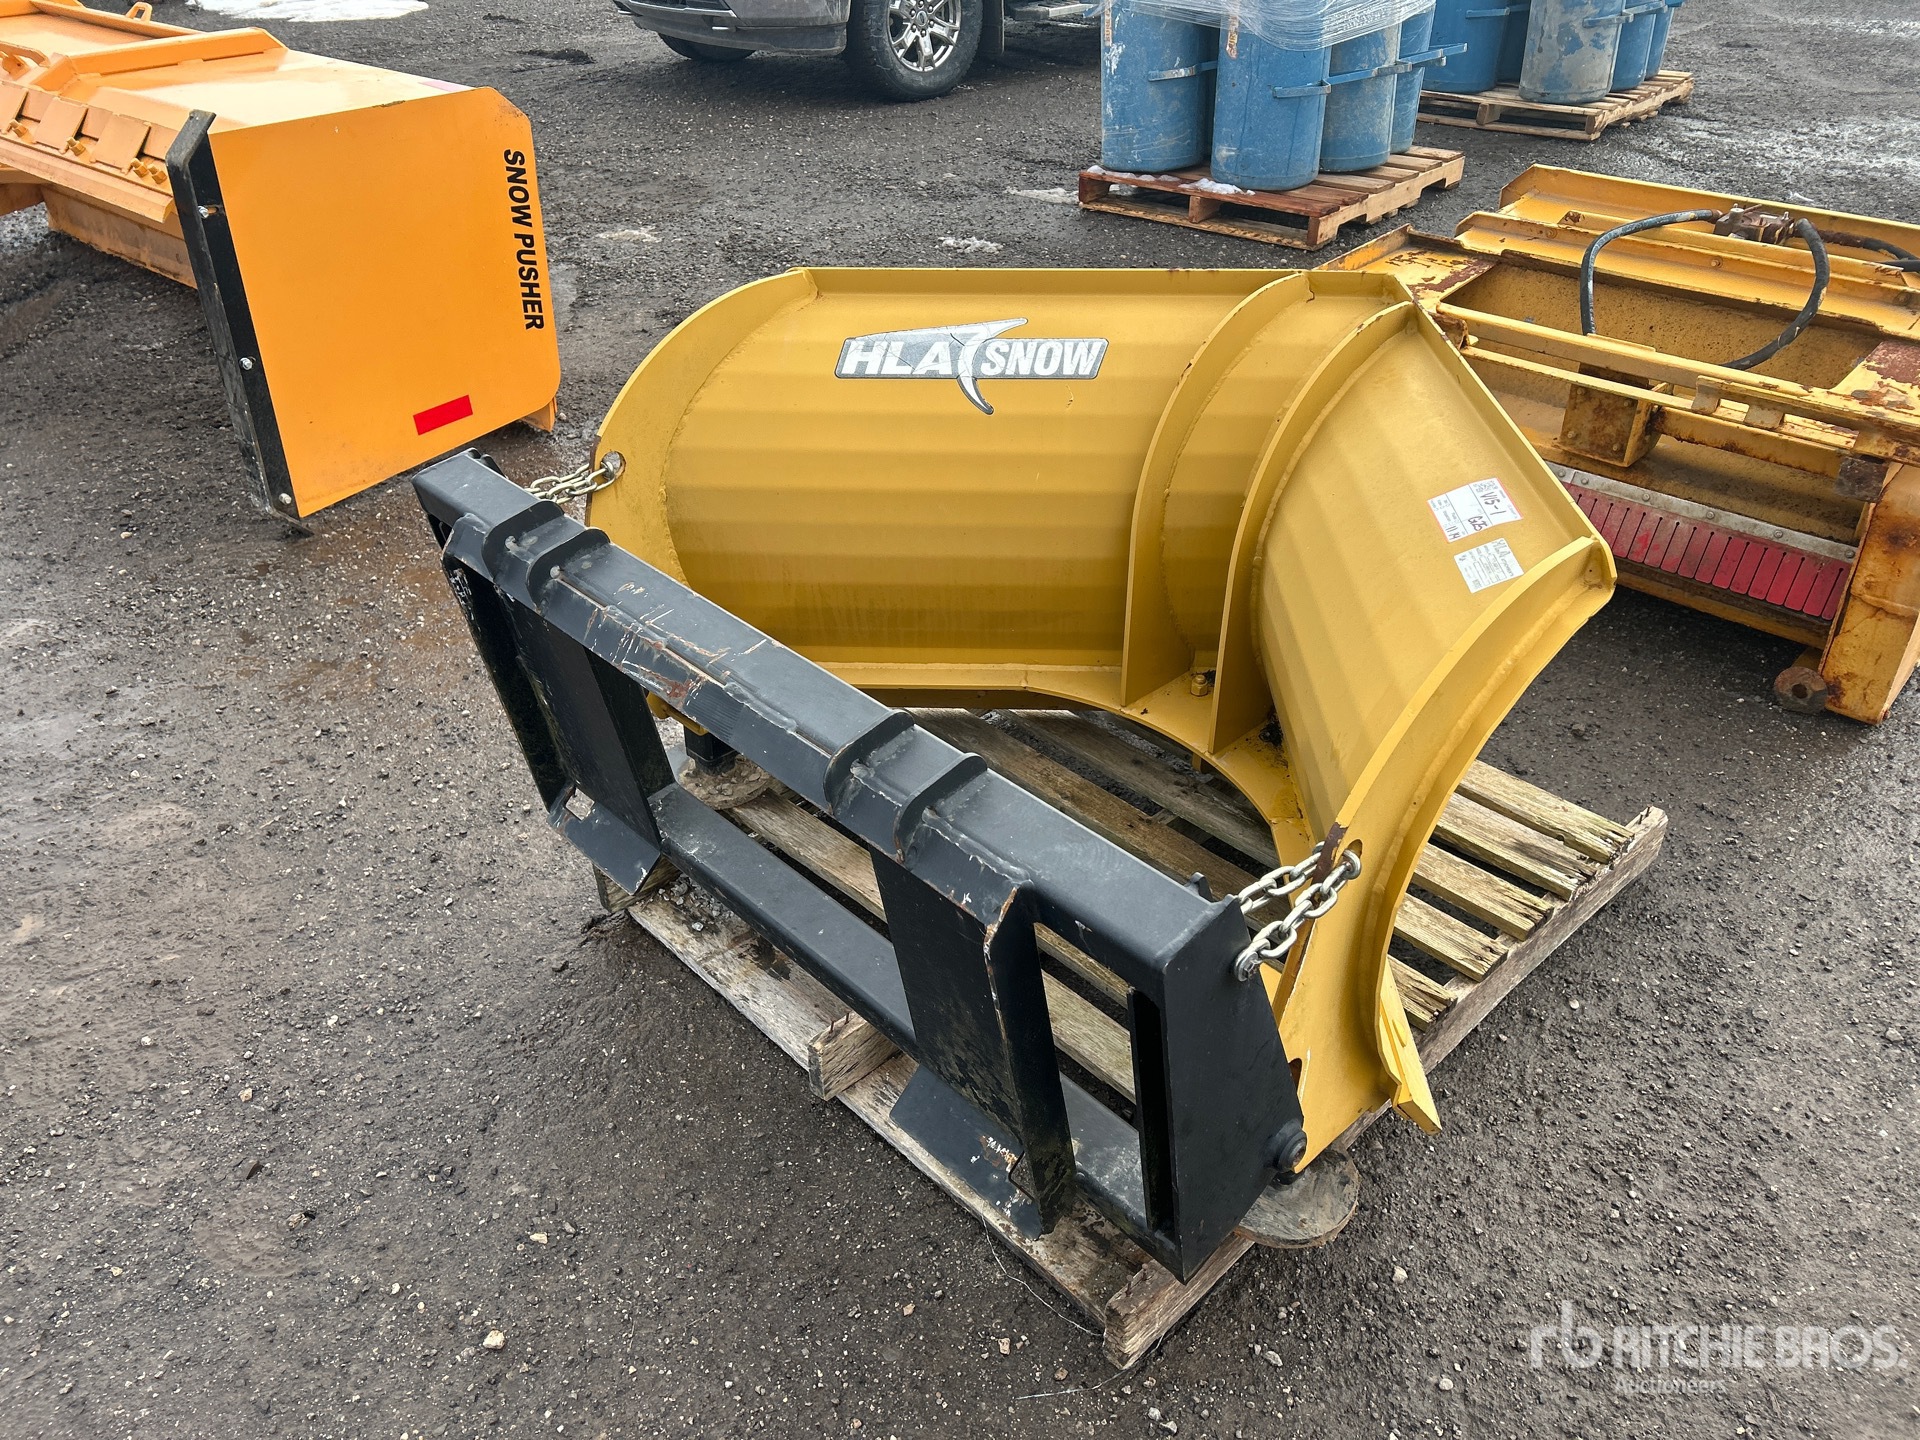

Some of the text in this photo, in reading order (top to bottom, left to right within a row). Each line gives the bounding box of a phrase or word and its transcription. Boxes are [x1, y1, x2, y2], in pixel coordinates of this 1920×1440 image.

[503, 149, 545, 330] SNOW PUSHER
[841, 341, 1102, 376] HLA SNOW
